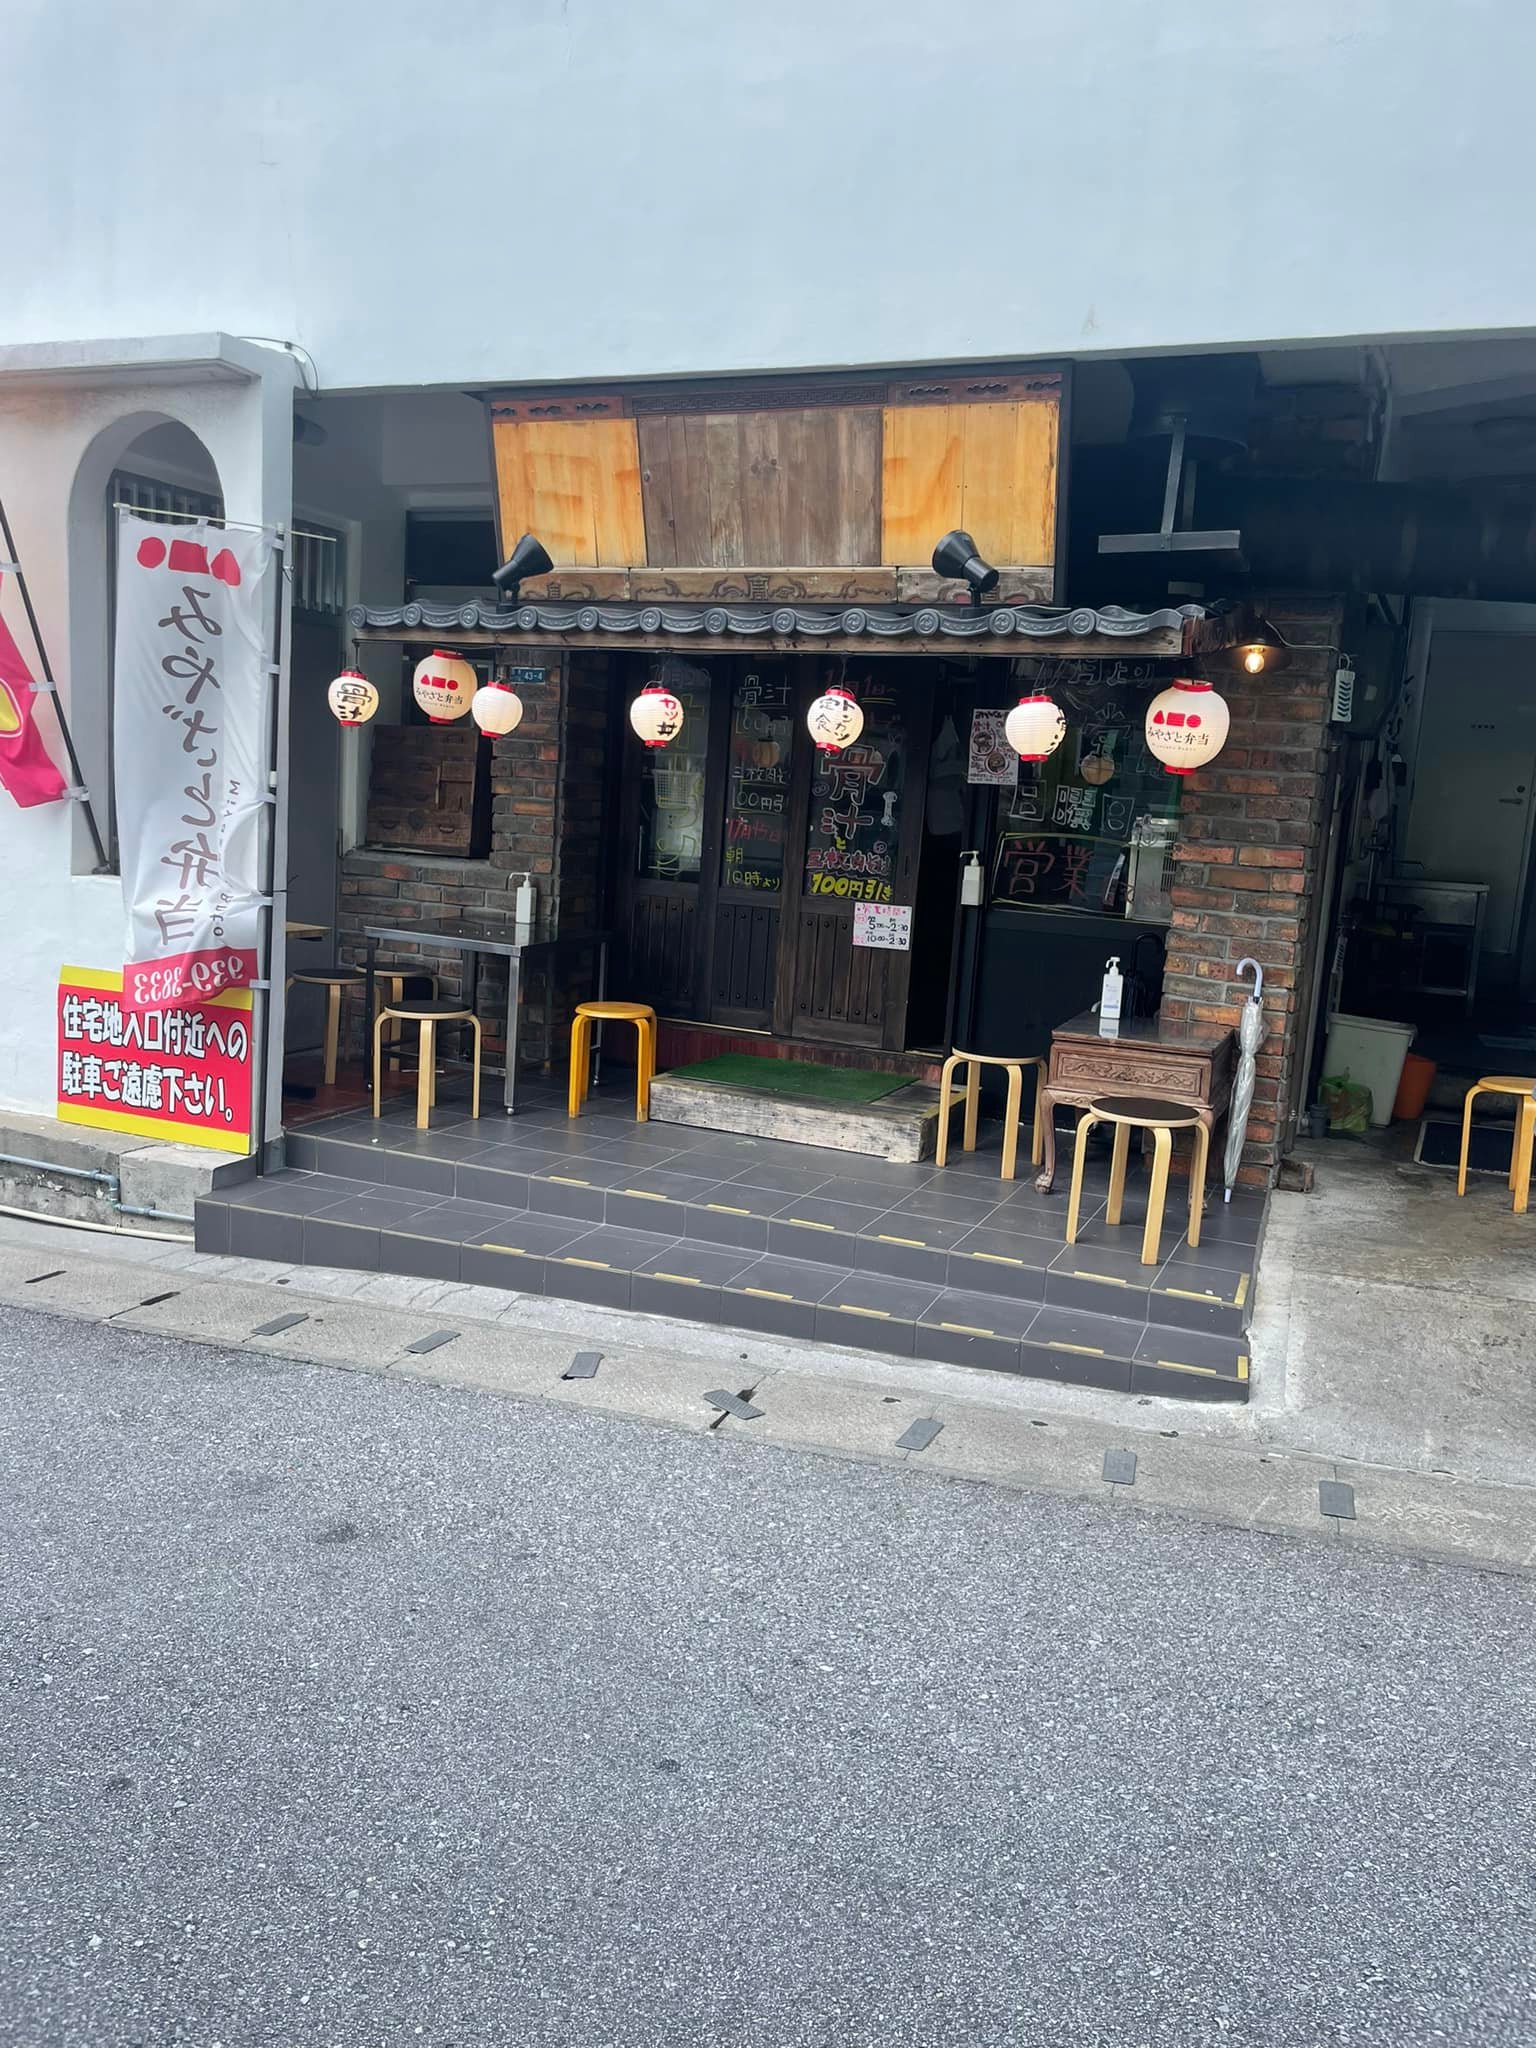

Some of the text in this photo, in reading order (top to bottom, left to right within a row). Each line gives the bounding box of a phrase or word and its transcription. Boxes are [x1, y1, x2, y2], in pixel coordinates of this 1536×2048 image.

[738, 673, 792, 705] 骨汁
[811, 872, 893, 902] 100円引き
[62, 993, 248, 1064] 住宅地入口付近への
[61, 1050, 234, 1122] 駐車ご遠慮下さい。
